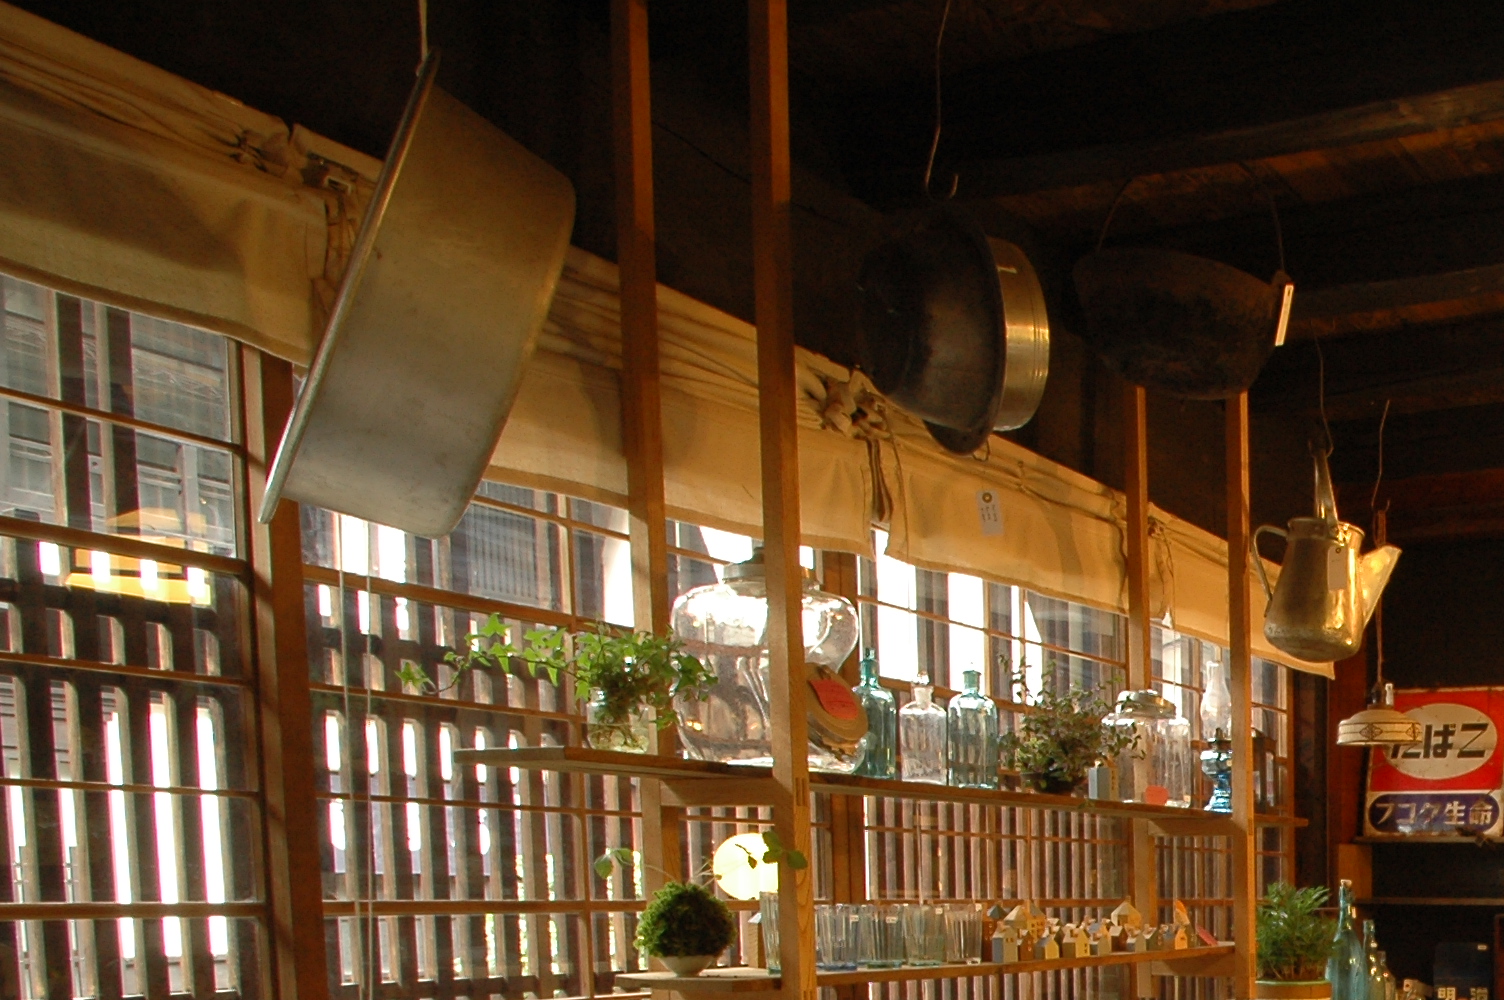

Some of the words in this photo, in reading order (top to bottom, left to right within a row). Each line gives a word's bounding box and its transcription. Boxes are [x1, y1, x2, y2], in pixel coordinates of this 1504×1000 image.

[1375, 801, 1493, 825] フコク生命
